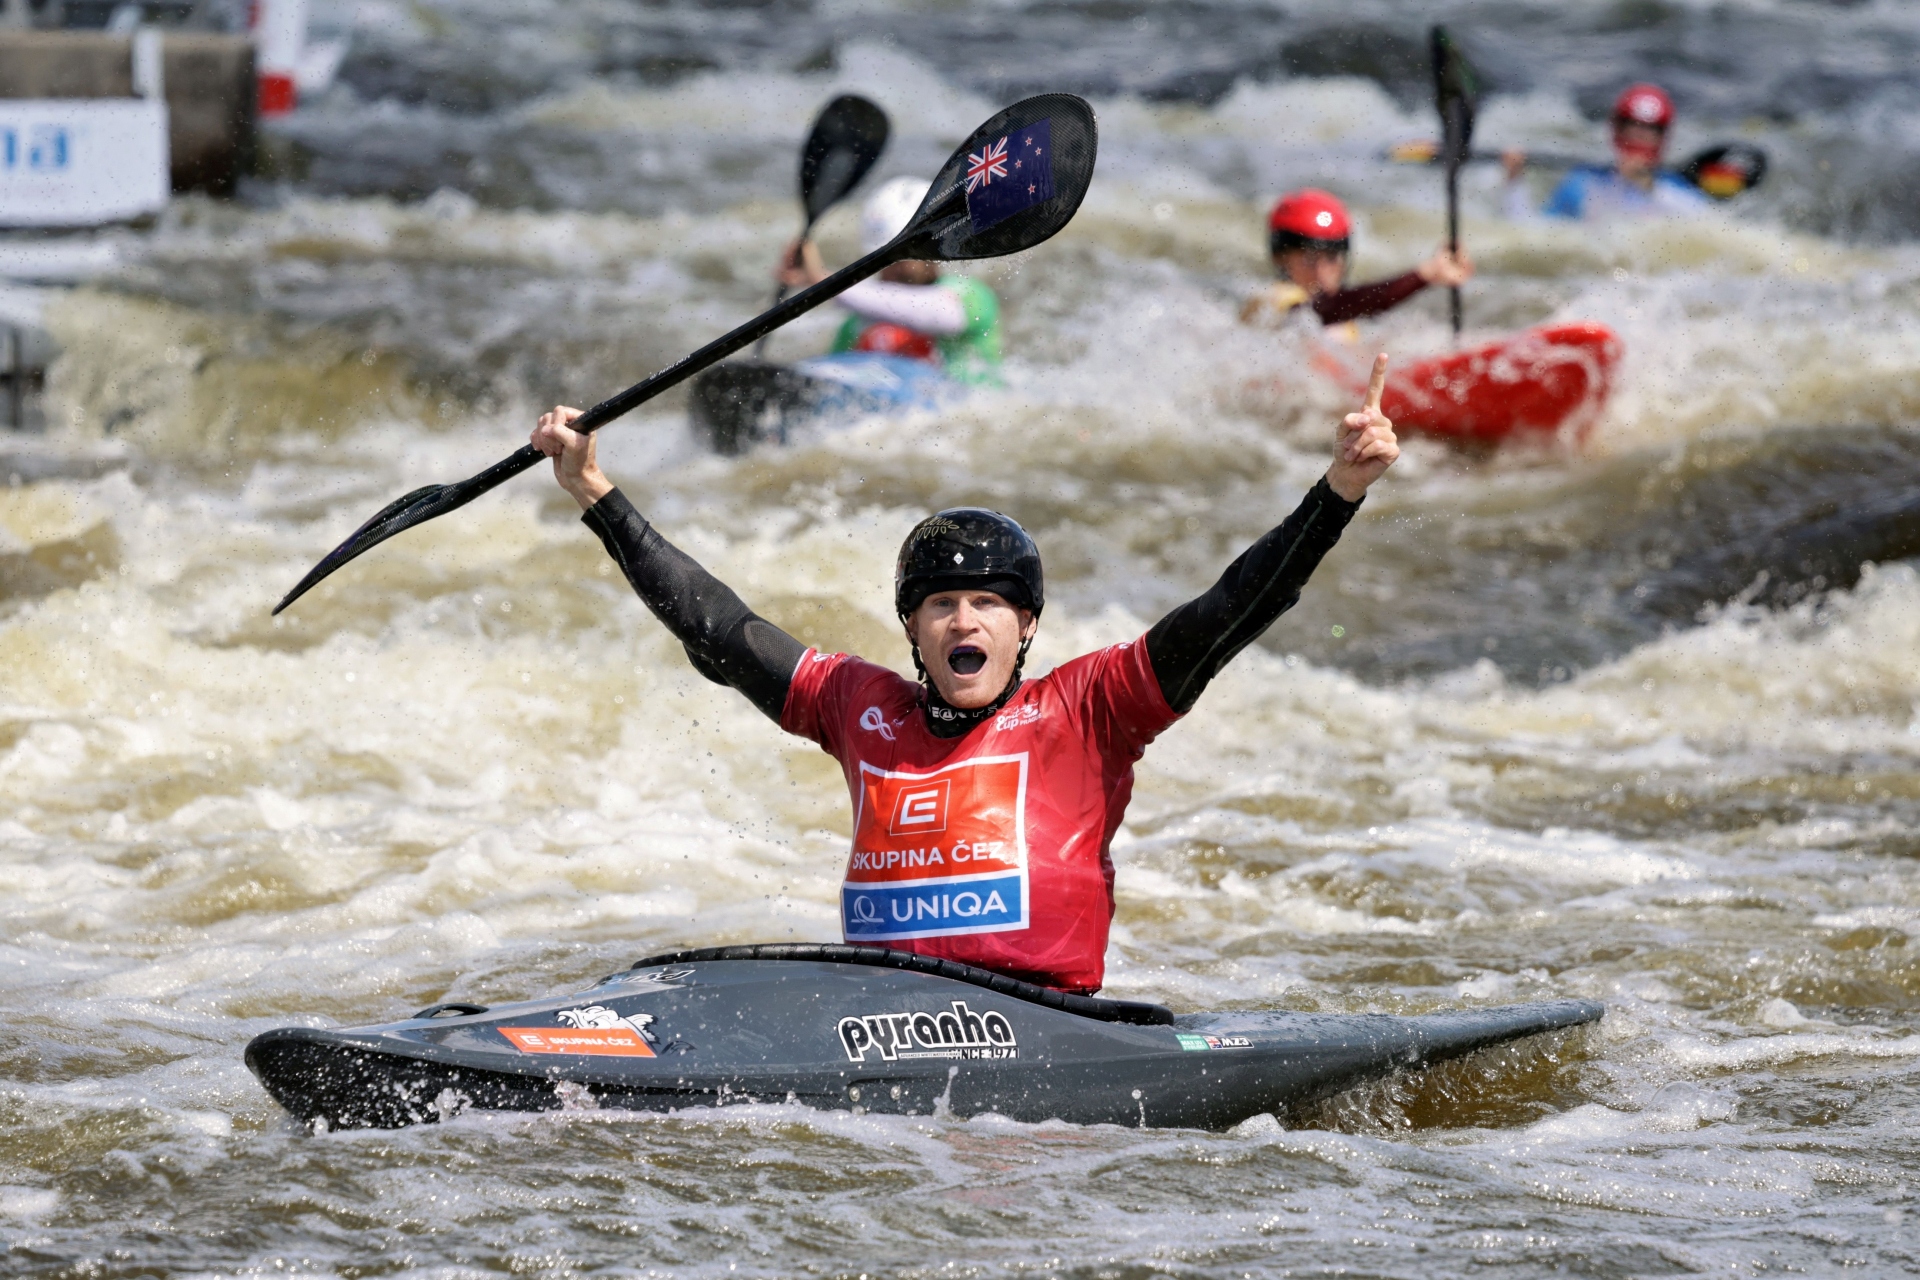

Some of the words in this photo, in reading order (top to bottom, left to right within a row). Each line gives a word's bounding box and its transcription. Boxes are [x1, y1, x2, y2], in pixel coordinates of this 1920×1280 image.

[852, 847, 945, 870] SKUPINA
[951, 839, 1005, 863] ČEZ
[891, 890, 1008, 922] UNIQA
[549, 1036, 607, 1046] SKUPINA
[606, 1036, 636, 1047] ČEZ
[837, 1000, 1017, 1062] pyranha
[988, 1047, 1019, 1060] 1971
